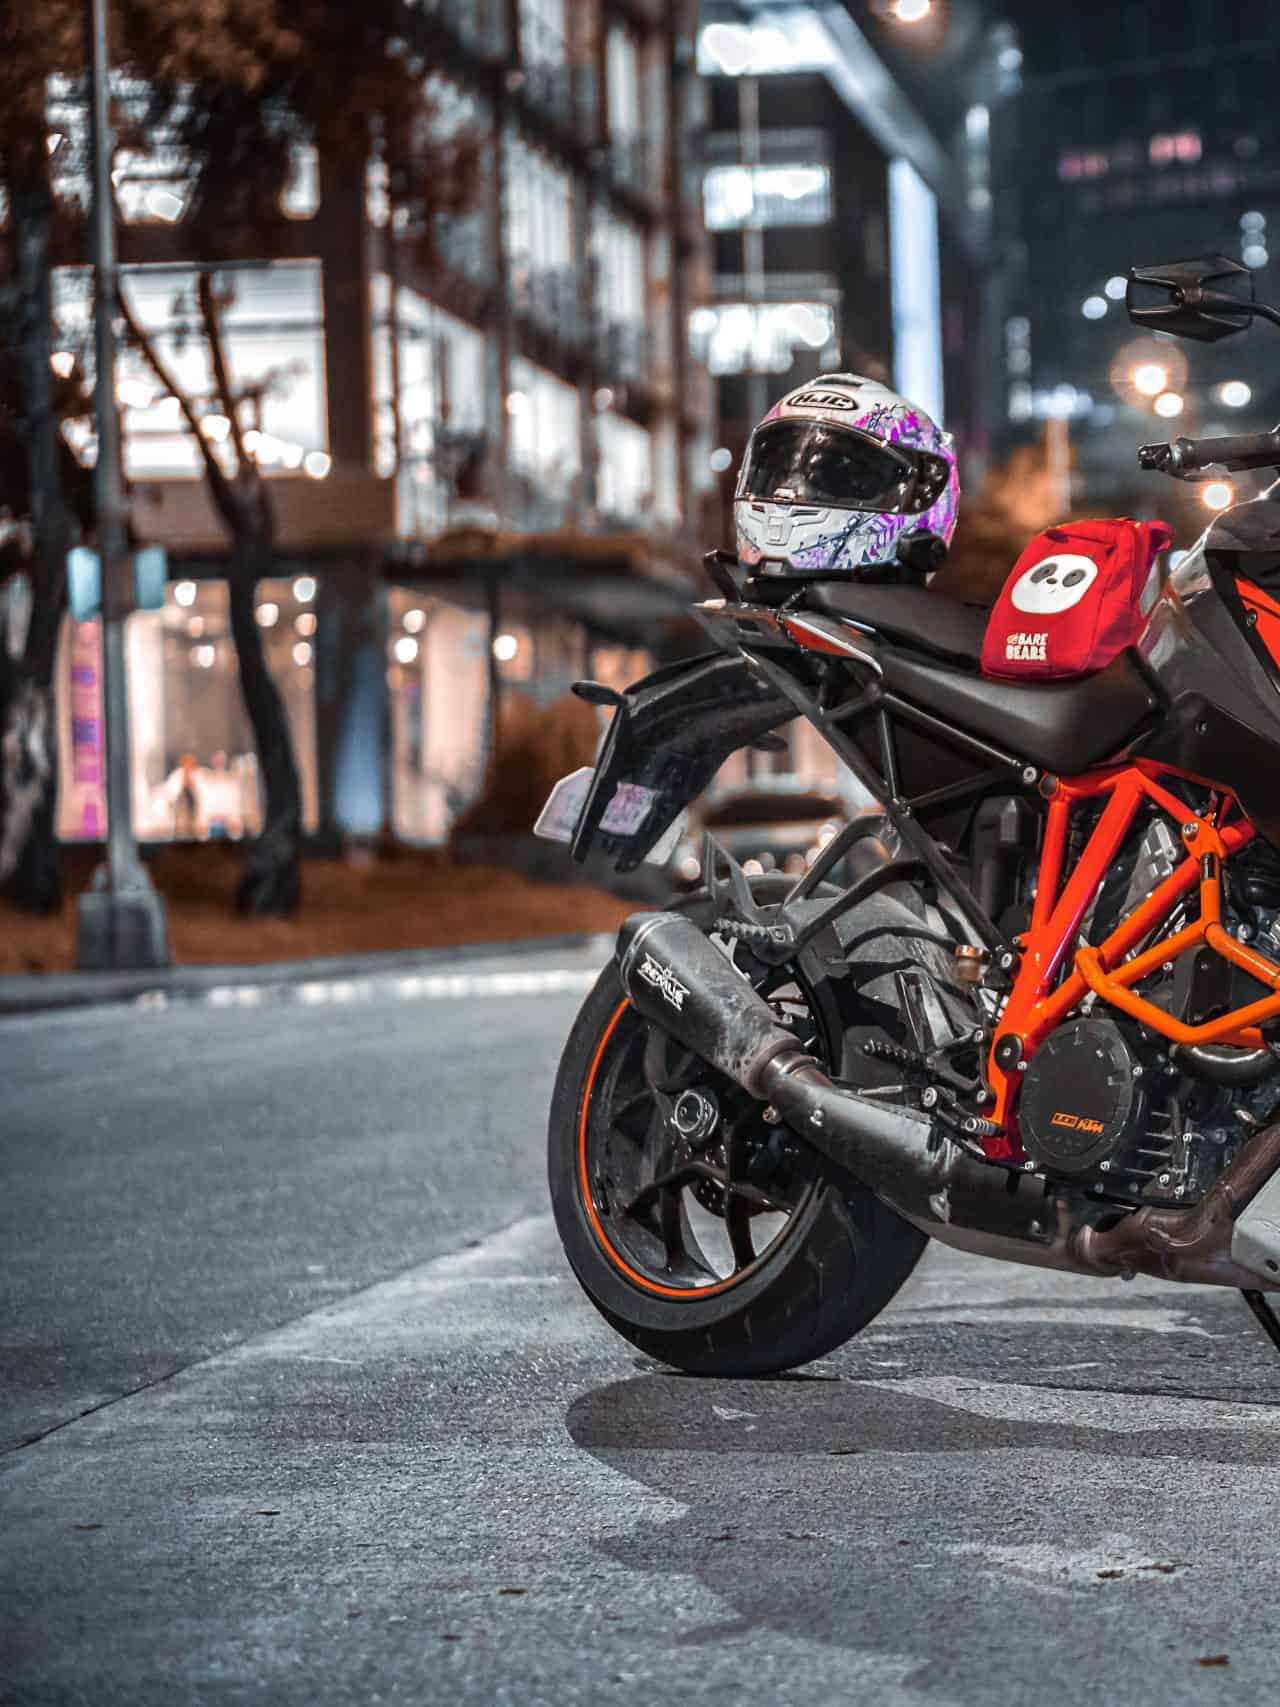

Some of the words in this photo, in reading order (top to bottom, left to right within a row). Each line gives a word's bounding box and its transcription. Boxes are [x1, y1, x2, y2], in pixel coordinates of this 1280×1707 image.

[796, 394, 851, 409] HJC
[1018, 632, 1048, 646] BARE
[1006, 645, 1047, 661] BEARS
[639, 960, 685, 1005] REMUS
[1077, 1119, 1104, 1133] KTM
